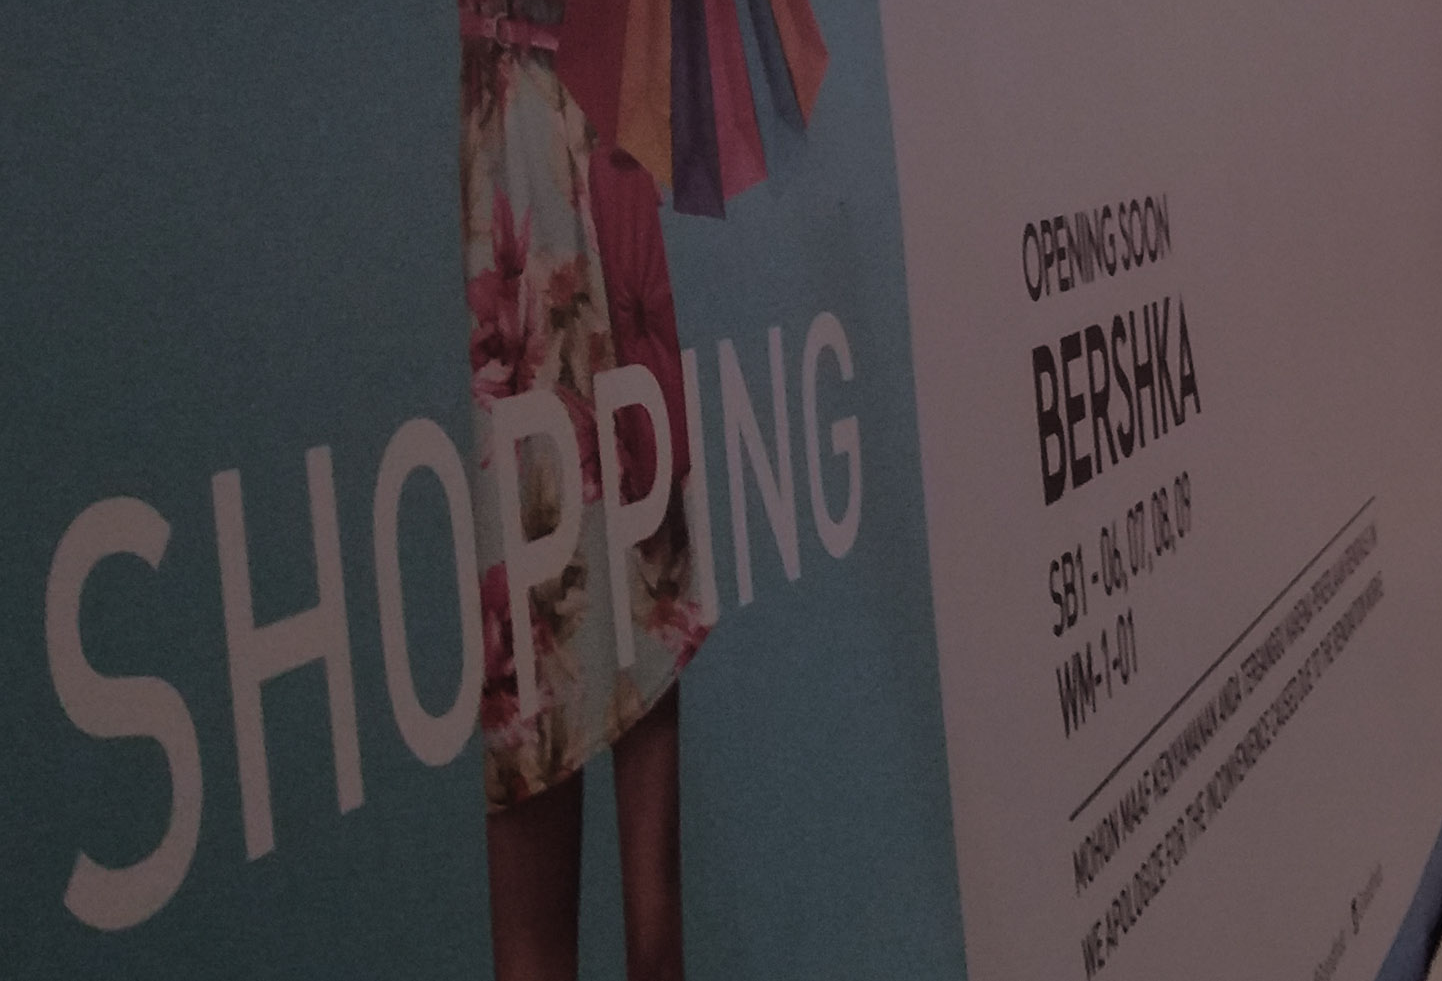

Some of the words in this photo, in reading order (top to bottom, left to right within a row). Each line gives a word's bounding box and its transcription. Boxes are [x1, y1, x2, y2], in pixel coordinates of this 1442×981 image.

[1022, 208, 1117, 302] OPENING
[1119, 193, 1171, 272] SOON
[1032, 293, 1201, 506] BERSHKA
[44, 311, 863, 931] SHOPPING
[1050, 543, 1087, 637] SB1
